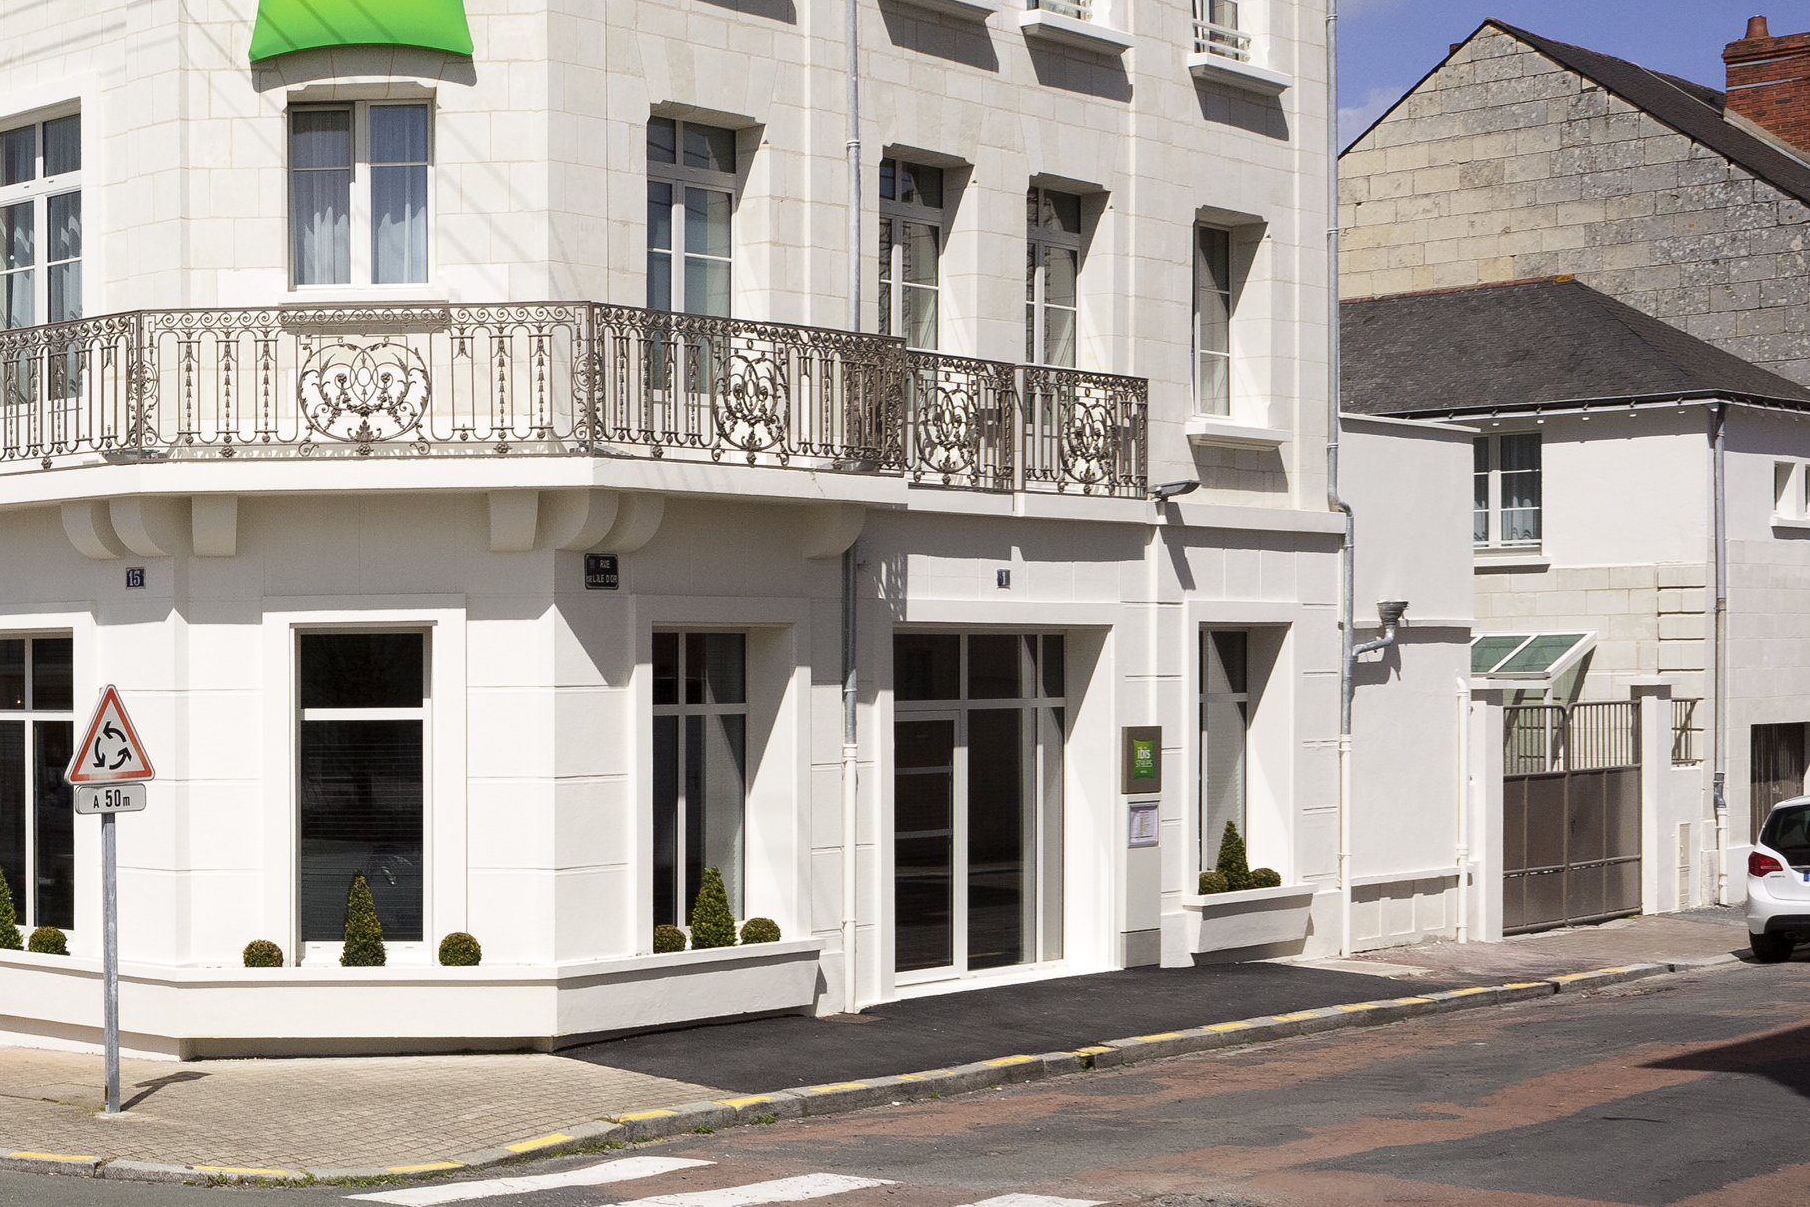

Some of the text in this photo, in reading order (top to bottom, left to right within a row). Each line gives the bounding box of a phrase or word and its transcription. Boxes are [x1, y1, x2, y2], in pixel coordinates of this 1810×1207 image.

[128, 570, 140, 586] 15
[1137, 746, 1150, 759] ibis
[93, 795, 100, 809] A
